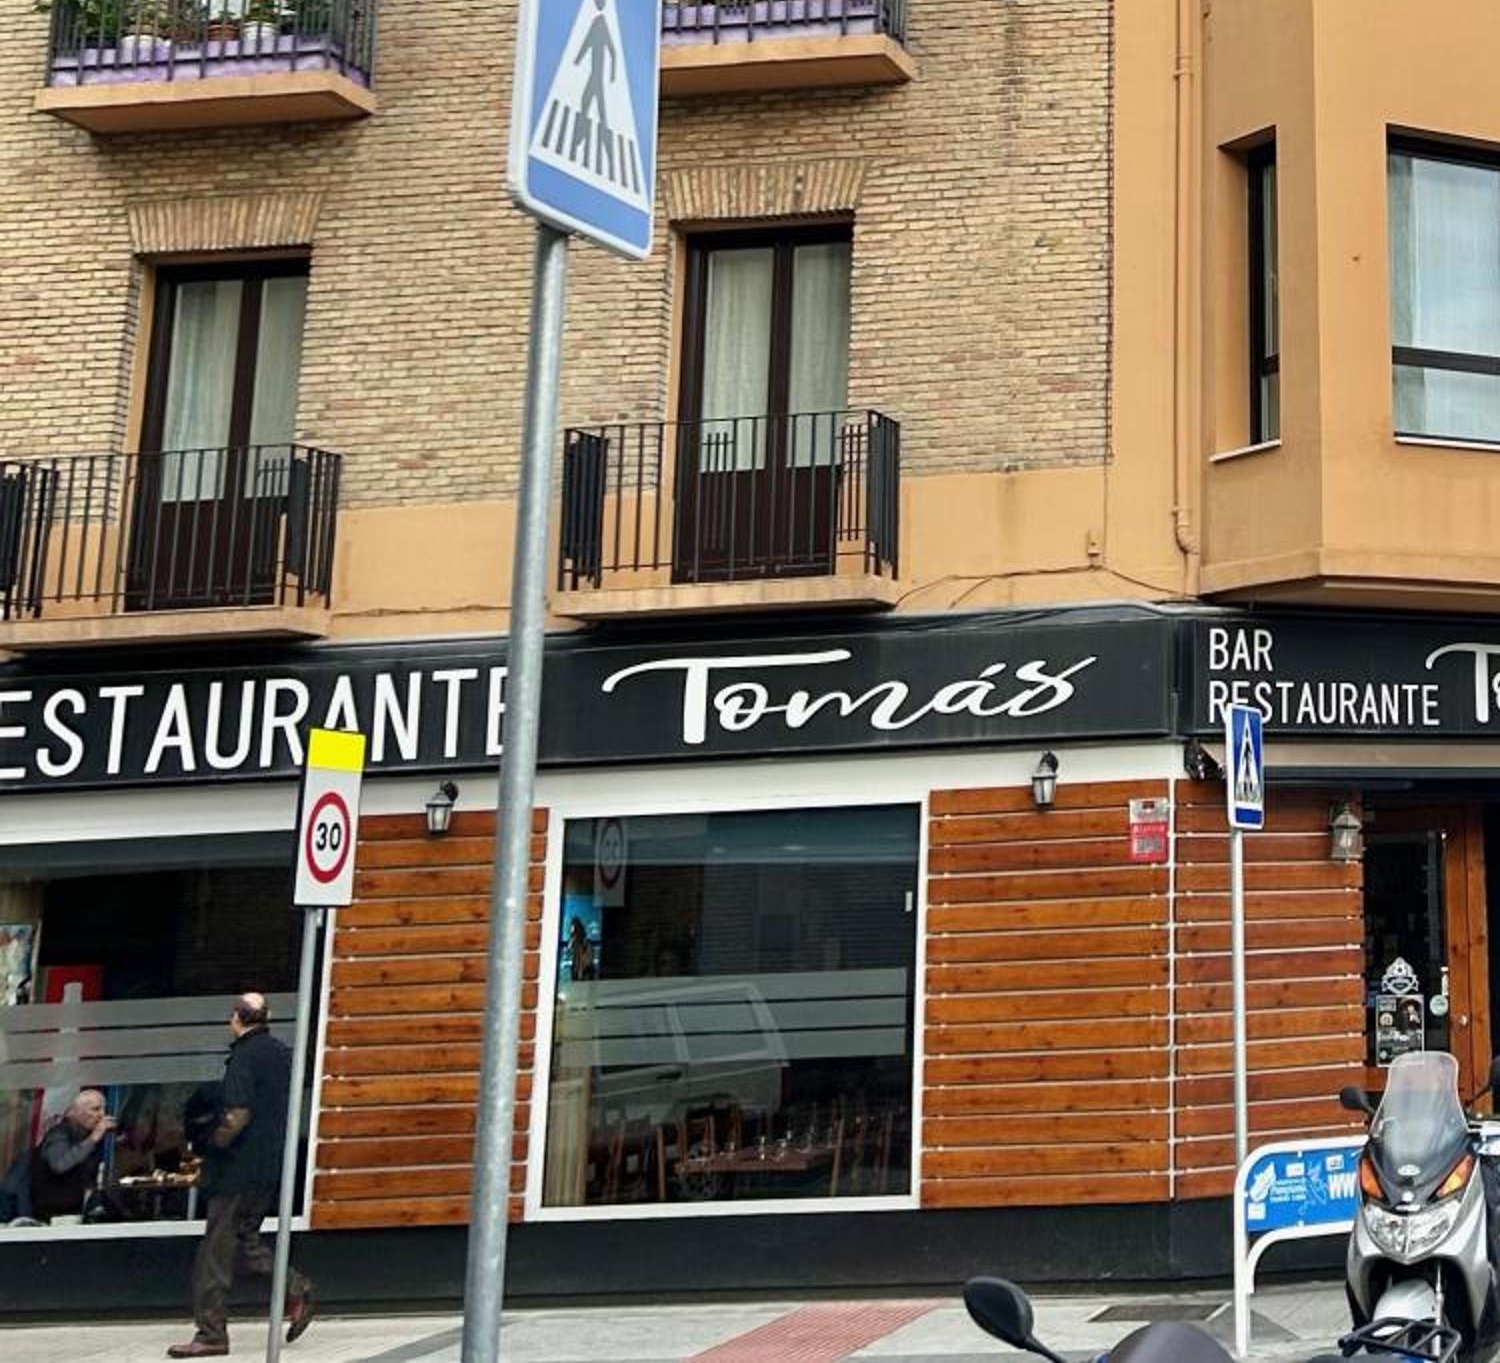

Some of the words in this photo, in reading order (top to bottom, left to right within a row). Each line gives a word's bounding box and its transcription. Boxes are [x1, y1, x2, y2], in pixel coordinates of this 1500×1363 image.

[1209, 628, 1273, 671] BAR
[601, 648, 1097, 745] Tomás
[1209, 680, 1440, 726] RESTAURANTE
[315, 821, 341, 852] 30
